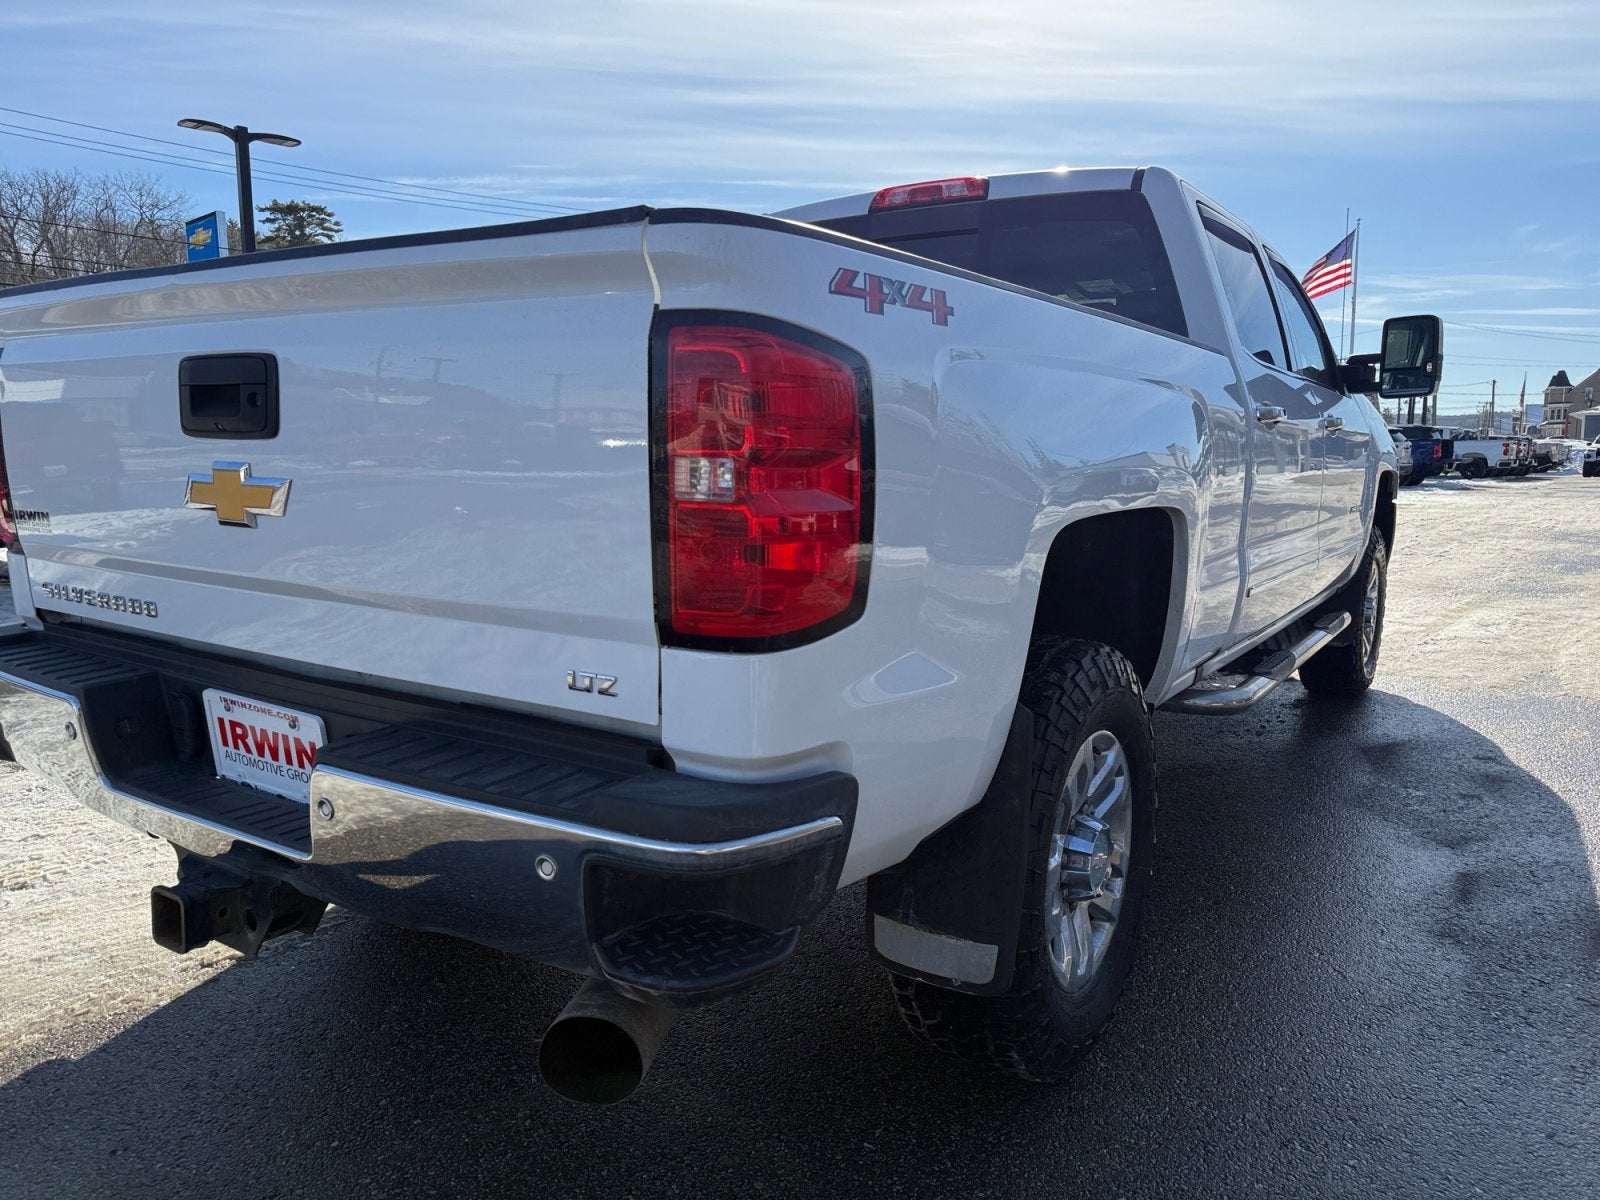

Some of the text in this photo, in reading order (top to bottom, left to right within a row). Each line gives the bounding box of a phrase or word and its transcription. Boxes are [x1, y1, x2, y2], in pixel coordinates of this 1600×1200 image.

[15, 509, 50, 522] IRWIN
[42, 581, 158, 618] SILVERADO
[567, 669, 618, 697] LTZ
[219, 695, 299, 722] IRWINZONE.COM
[217, 716, 317, 769] IRWIN
[225, 750, 312, 784] AUTOMOTIVE GRO
